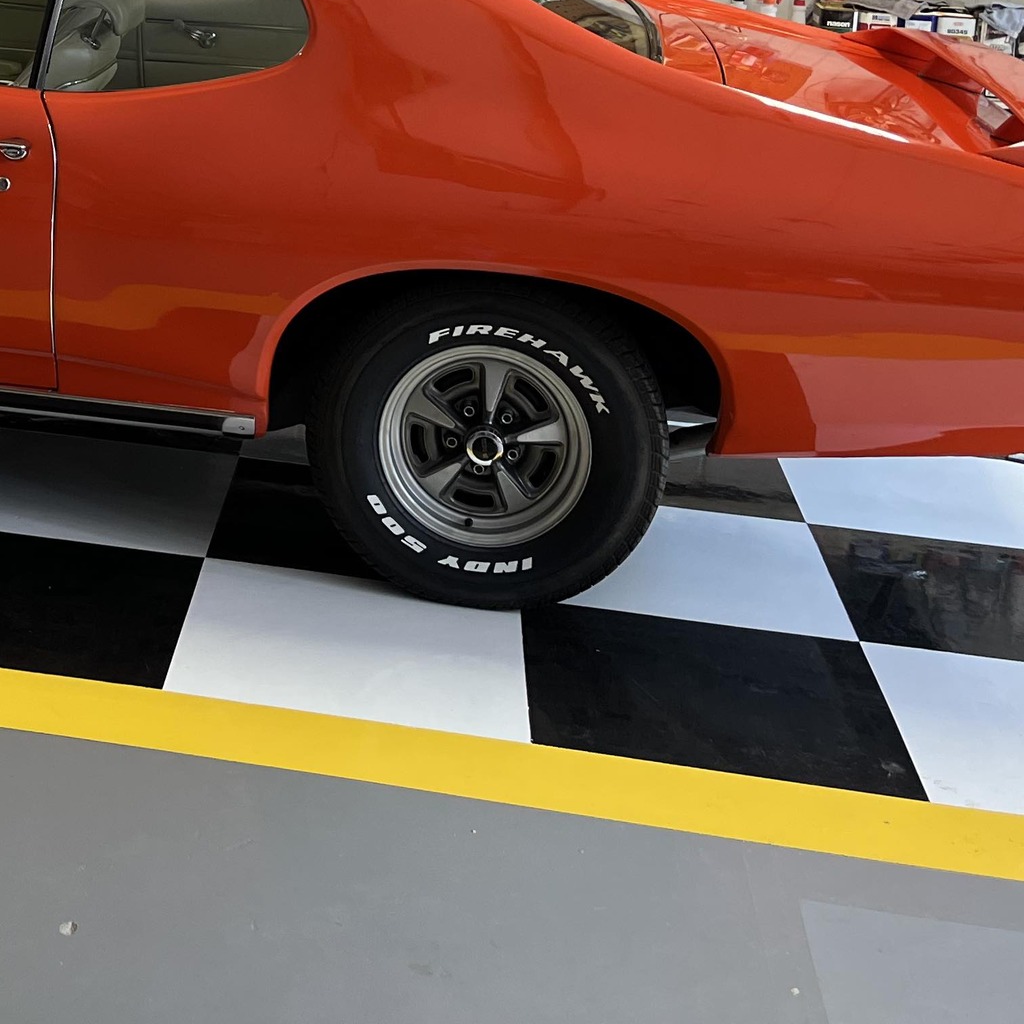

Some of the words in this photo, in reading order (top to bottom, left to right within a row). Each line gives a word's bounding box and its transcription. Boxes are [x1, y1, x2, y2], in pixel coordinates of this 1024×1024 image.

[428, 325, 611, 414] FIREHAWK
[366, 494, 427, 554] 500
[437, 555, 533, 574] INDY
